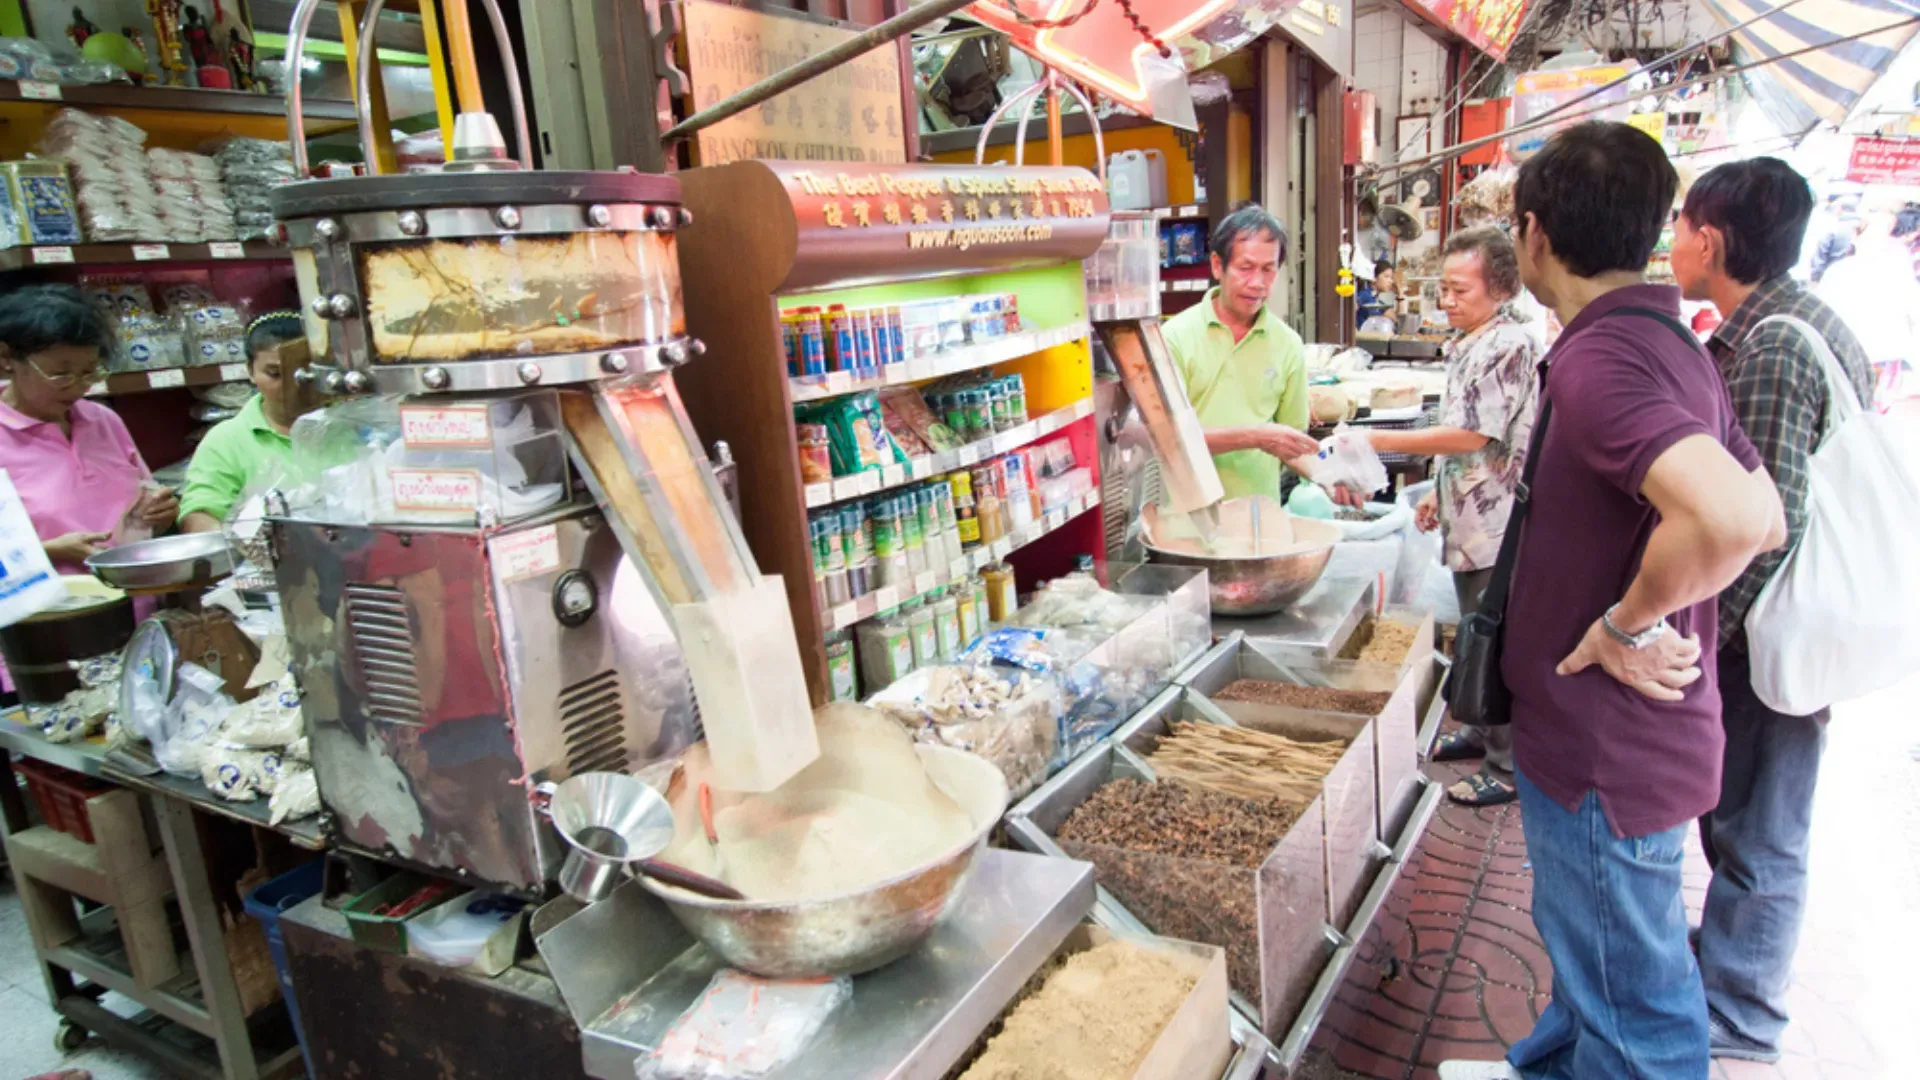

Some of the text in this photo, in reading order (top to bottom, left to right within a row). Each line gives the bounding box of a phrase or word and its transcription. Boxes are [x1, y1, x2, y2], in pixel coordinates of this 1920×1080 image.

[707, 136, 788, 163] BANGKOK
[793, 170, 838, 196] The
[837, 173, 881, 196] Best
[880, 173, 942, 200] Pepper
